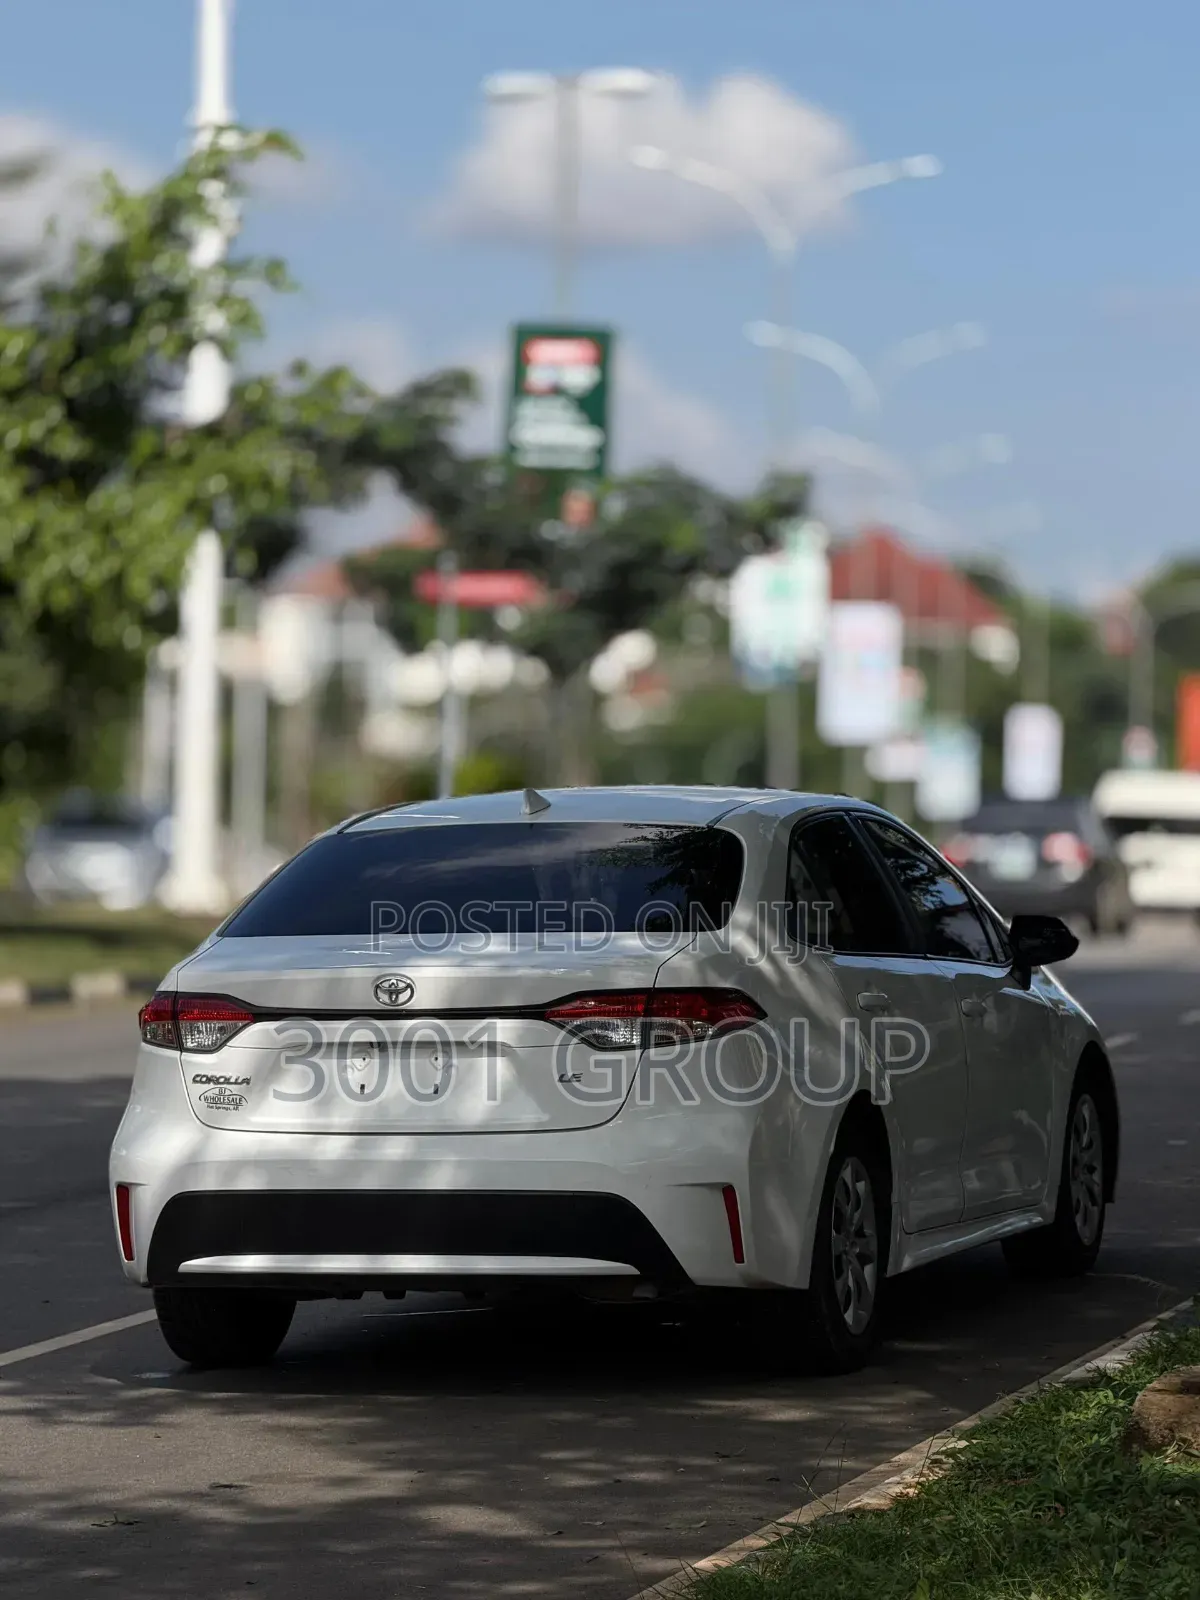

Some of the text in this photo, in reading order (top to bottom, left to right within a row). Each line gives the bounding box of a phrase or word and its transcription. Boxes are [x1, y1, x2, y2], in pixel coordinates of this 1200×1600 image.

[192, 1074, 252, 1086] COROLLA
[557, 1072, 584, 1083] LE
[203, 1095, 243, 1105] WHOLESALE
